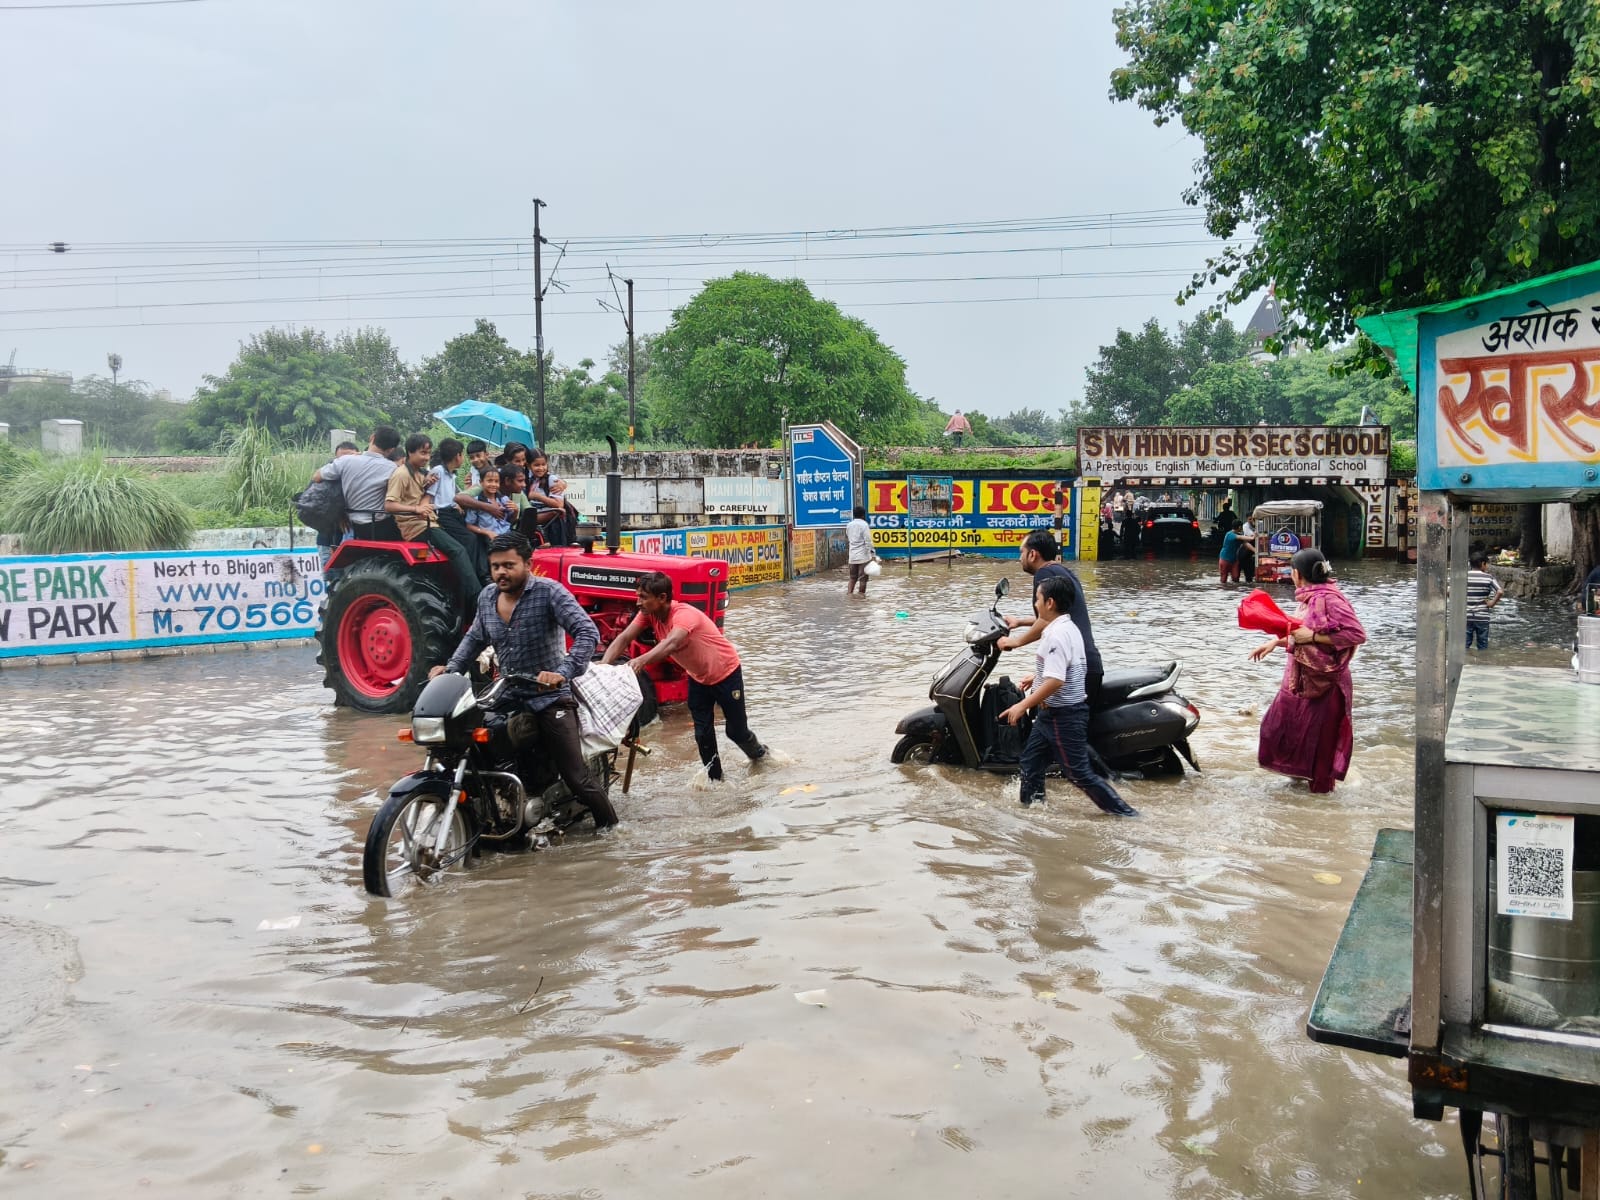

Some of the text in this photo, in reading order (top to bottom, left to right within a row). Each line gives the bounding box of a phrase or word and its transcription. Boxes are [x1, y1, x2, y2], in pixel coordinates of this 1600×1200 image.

[1483, 299, 1582, 353] अशोक
[1136, 435, 1210, 457] HINDU
[1215, 434, 1249, 457] SR
[1251, 434, 1292, 456] SEC
[1295, 433, 1388, 456] SCHOOL
[1085, 462, 1092, 472] A
[1096, 461, 1148, 474] Prestigious
[1155, 461, 1190, 474] English
[1196, 460, 1235, 472] Medium
[1329, 460, 1367, 471] School
[987, 482, 1069, 512] ICS
[719, 504, 768, 513] CAREFULLY
[868, 515, 900, 528] ICS
[986, 513, 1029, 527] सरकारी
[1367, 494, 1384, 545] YEARS
[1470, 516, 1513, 525] LASSES
[712, 532, 738, 547] DEVA
[741, 530, 766, 544] FARM
[872, 531, 958, 544] 9053002040
[1469, 528, 1511, 537] NSPORT
[664, 533, 683, 551] PTE
[757, 543, 780, 562] POOL
[153, 556, 320, 580] Next to Bhigan toll
[33, 564, 109, 602] PARK
[27, 601, 119, 640] PARK
[152, 601, 323, 634] M. 70566
[1522, 820, 1564, 832] Google Pay
